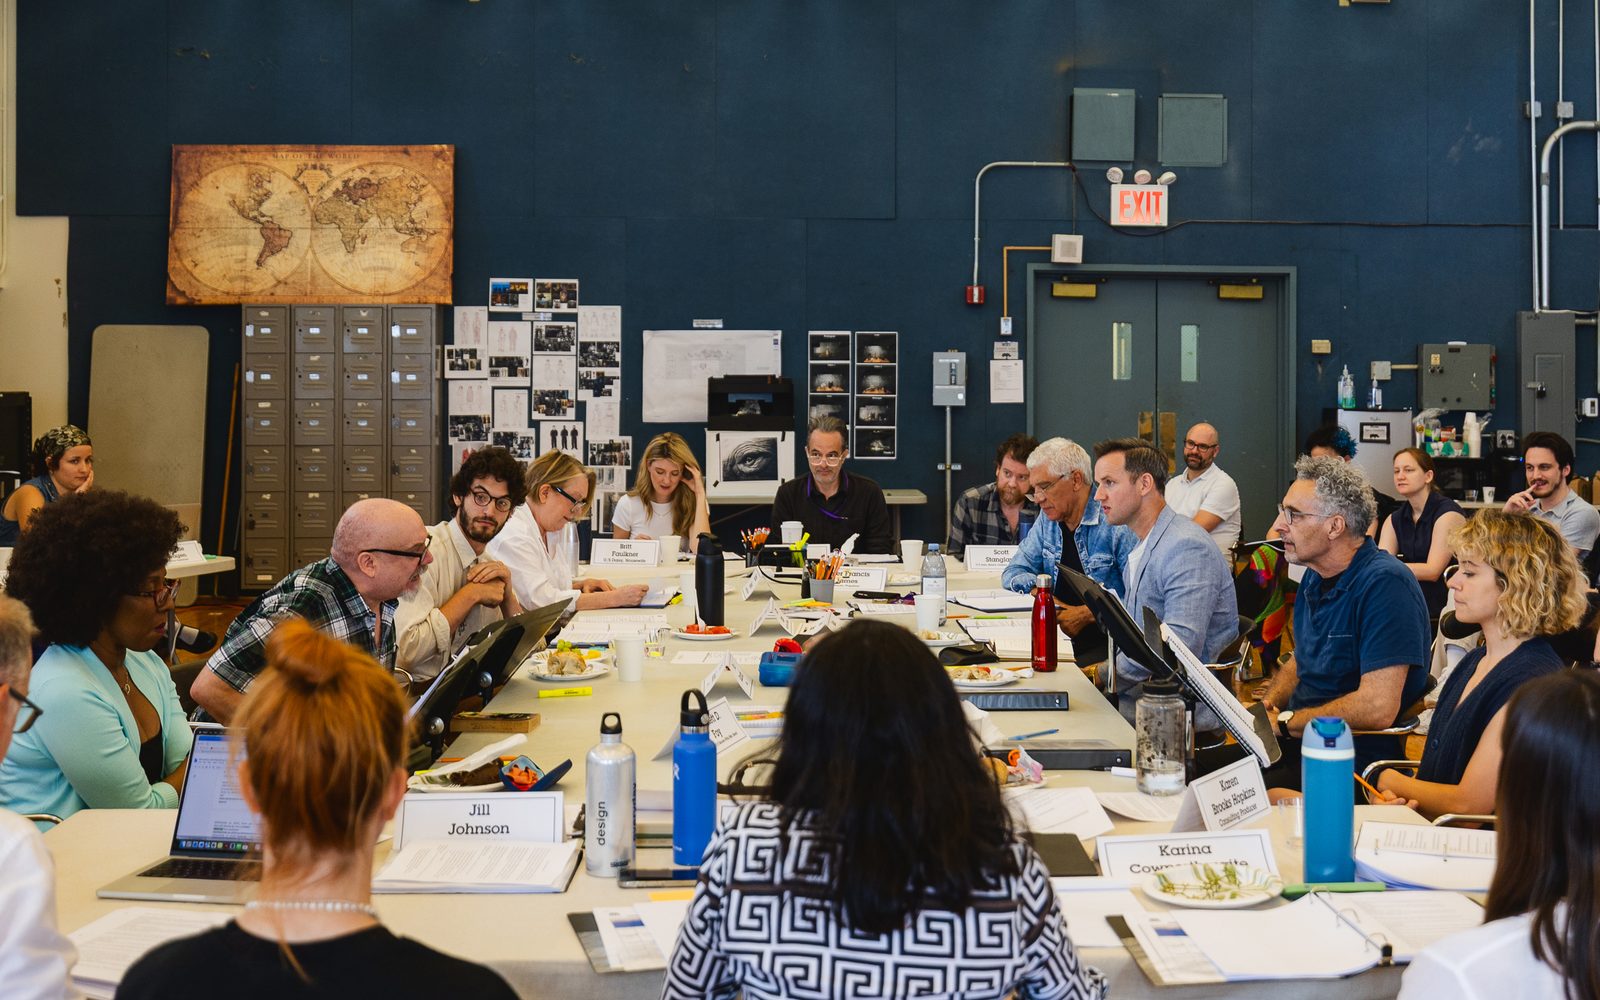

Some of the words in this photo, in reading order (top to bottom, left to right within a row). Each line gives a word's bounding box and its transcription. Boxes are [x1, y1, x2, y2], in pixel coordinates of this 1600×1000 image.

[1119, 190, 1163, 224] EXIT
[1219, 776, 1240, 792] Karen
[1211, 797, 1233, 815] Brooks
[1231, 787, 1256, 805] Hopkins
[469, 804, 491, 816] Jill
[447, 823, 510, 836] Johnson
[596, 801, 608, 846] design
[1158, 844, 1213, 857] Karina
